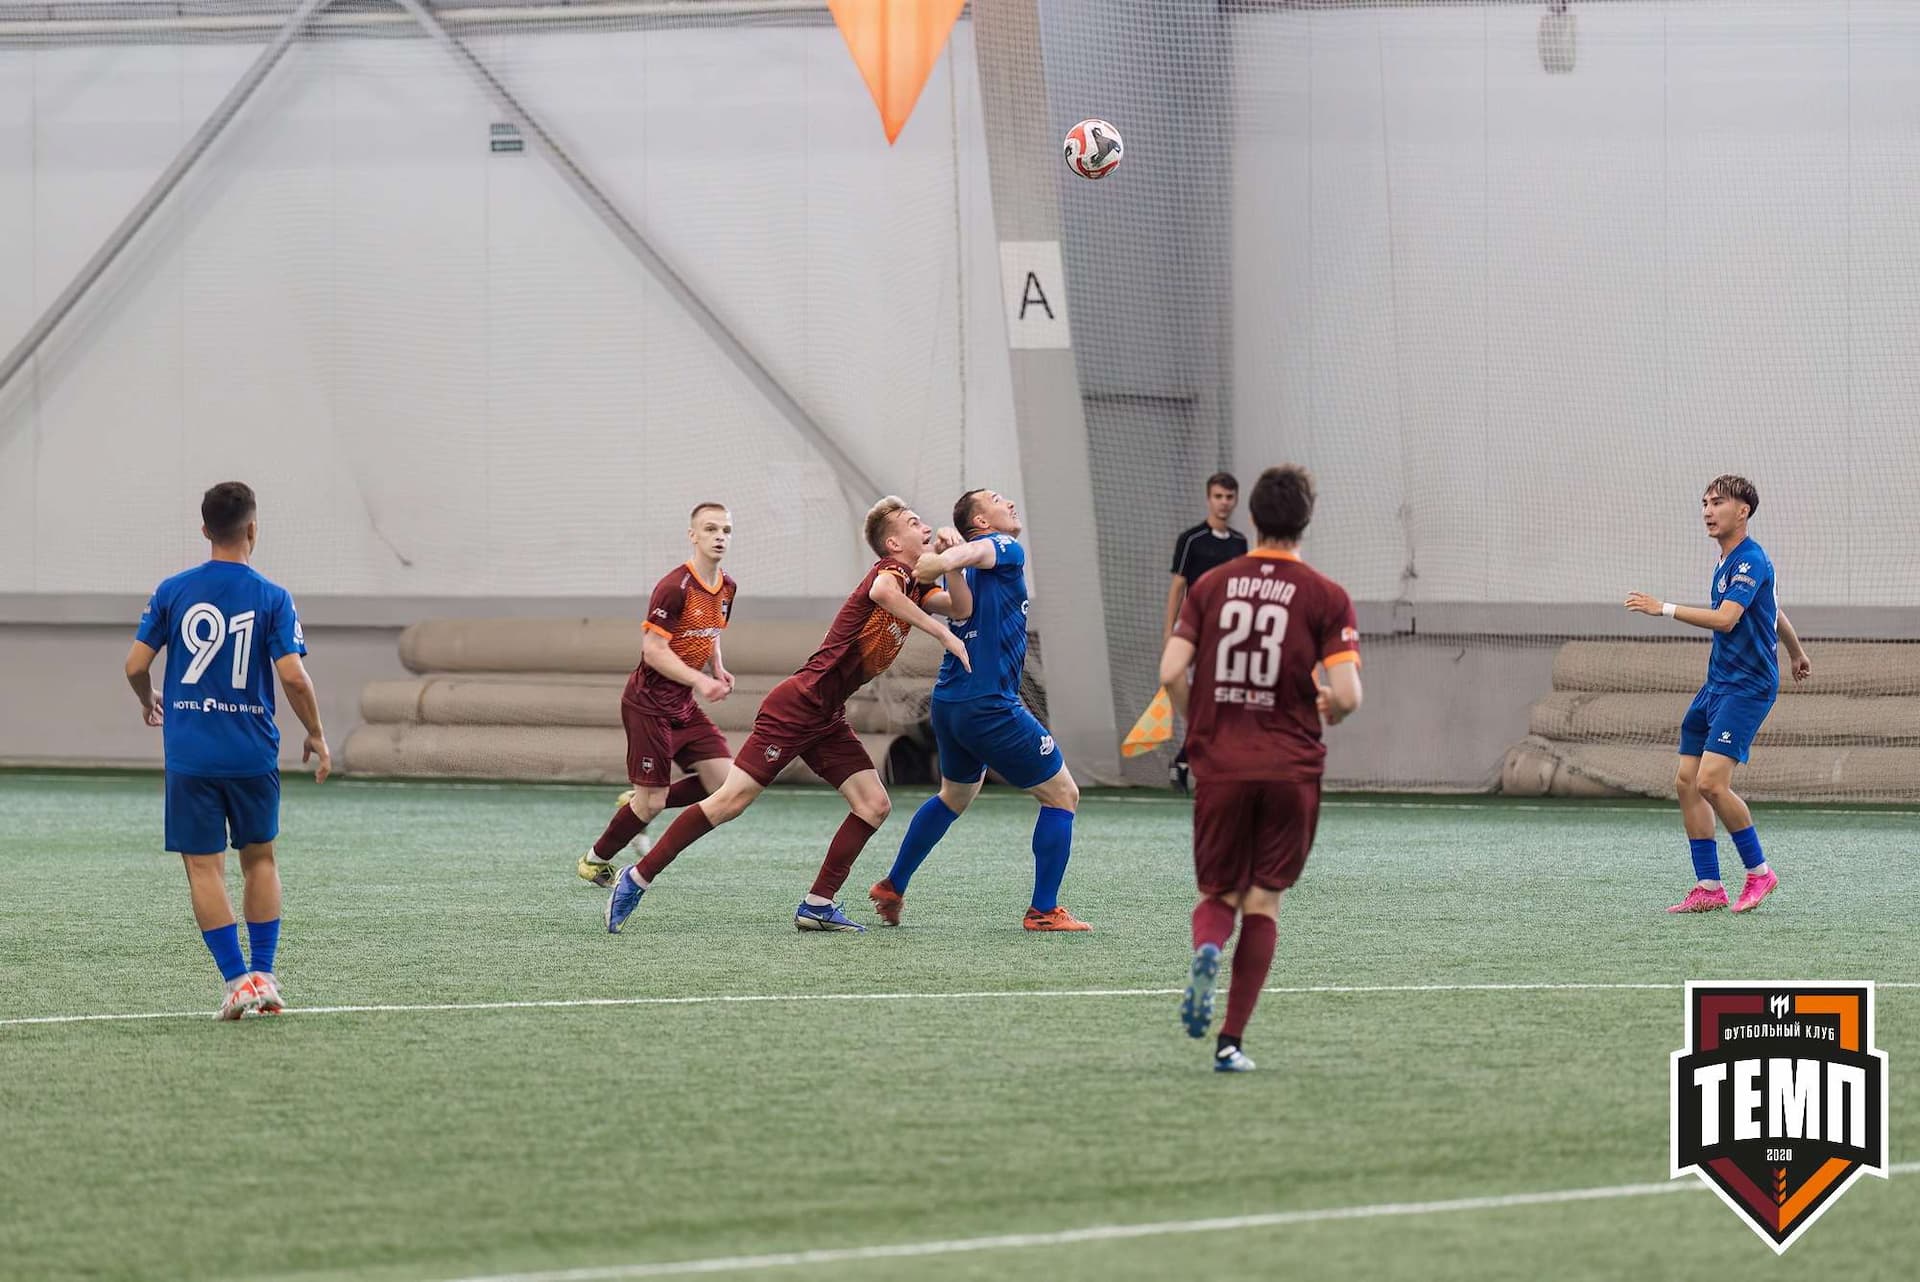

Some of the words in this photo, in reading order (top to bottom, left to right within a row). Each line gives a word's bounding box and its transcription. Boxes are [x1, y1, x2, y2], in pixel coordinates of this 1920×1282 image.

[1019, 271, 1054, 320] A
[1226, 577, 1296, 605] ВОРОНА
[181, 602, 255, 689] 91
[1215, 600, 1288, 687] 23
[173, 700, 201, 711] HOTEL
